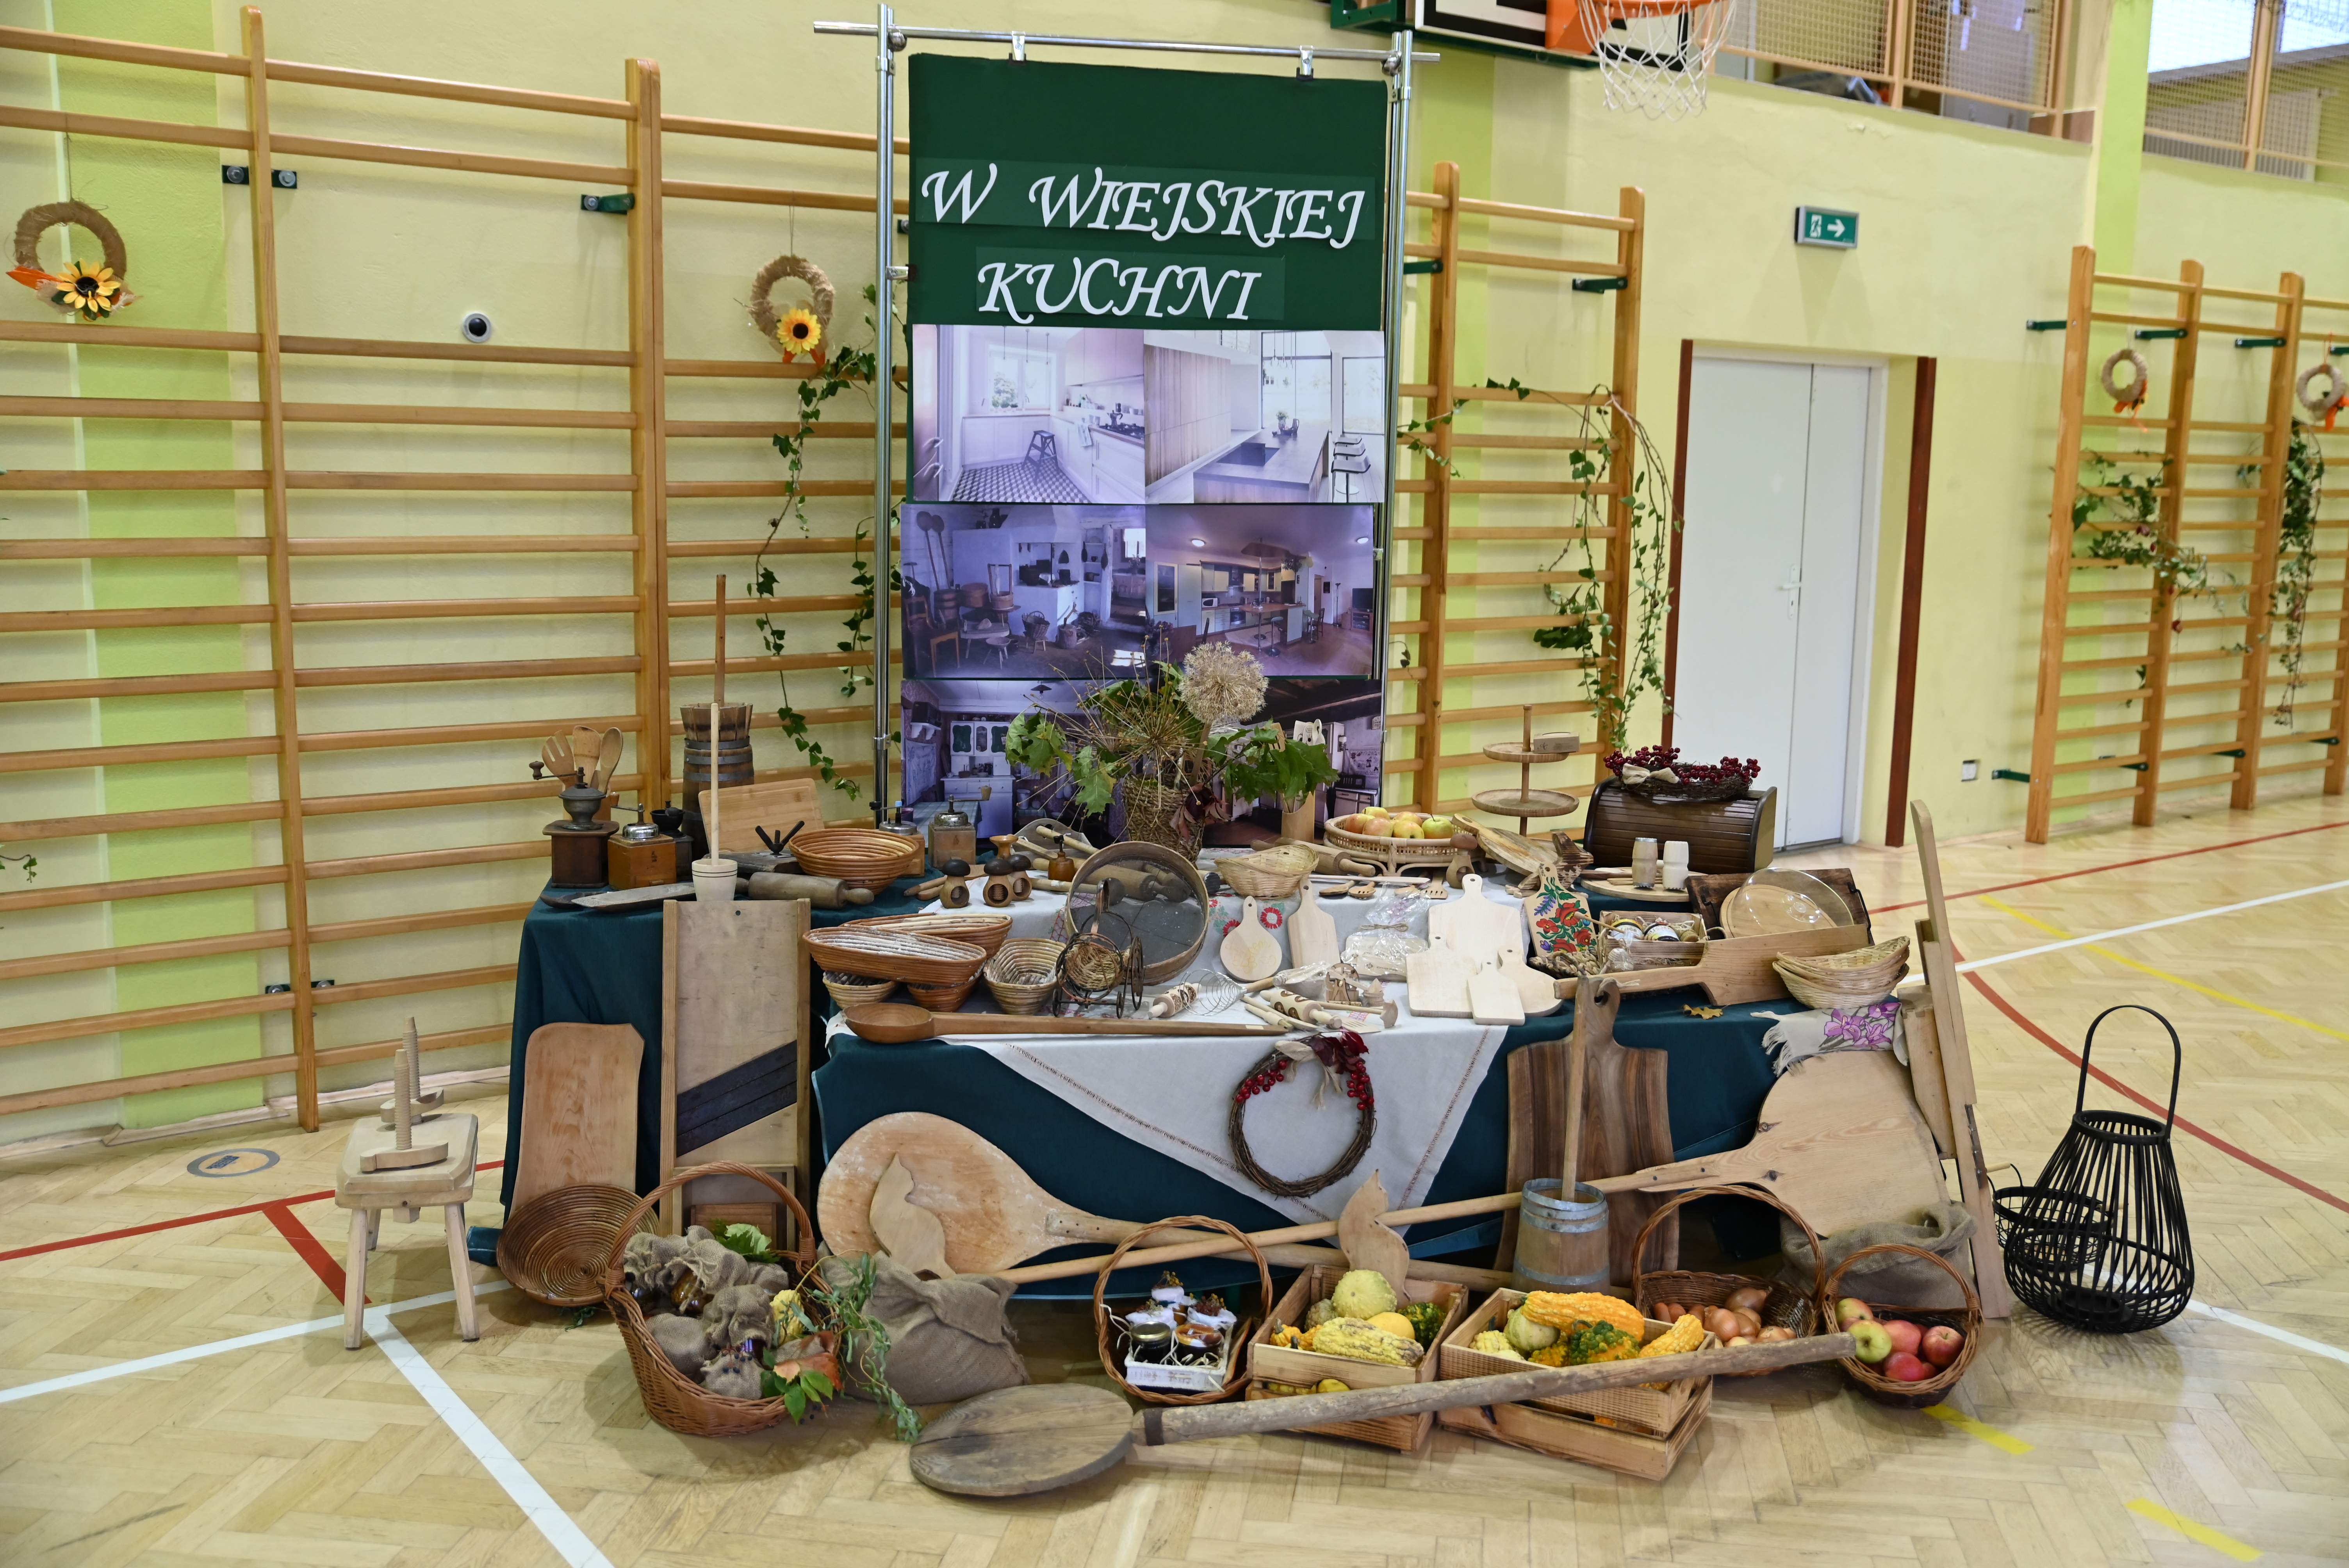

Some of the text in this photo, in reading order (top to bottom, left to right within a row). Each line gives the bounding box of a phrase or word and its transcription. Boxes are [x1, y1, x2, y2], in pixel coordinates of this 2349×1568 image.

[921, 163, 1365, 249] W WIEJSKIEJ
[978, 257, 1262, 324] KUCHNI
